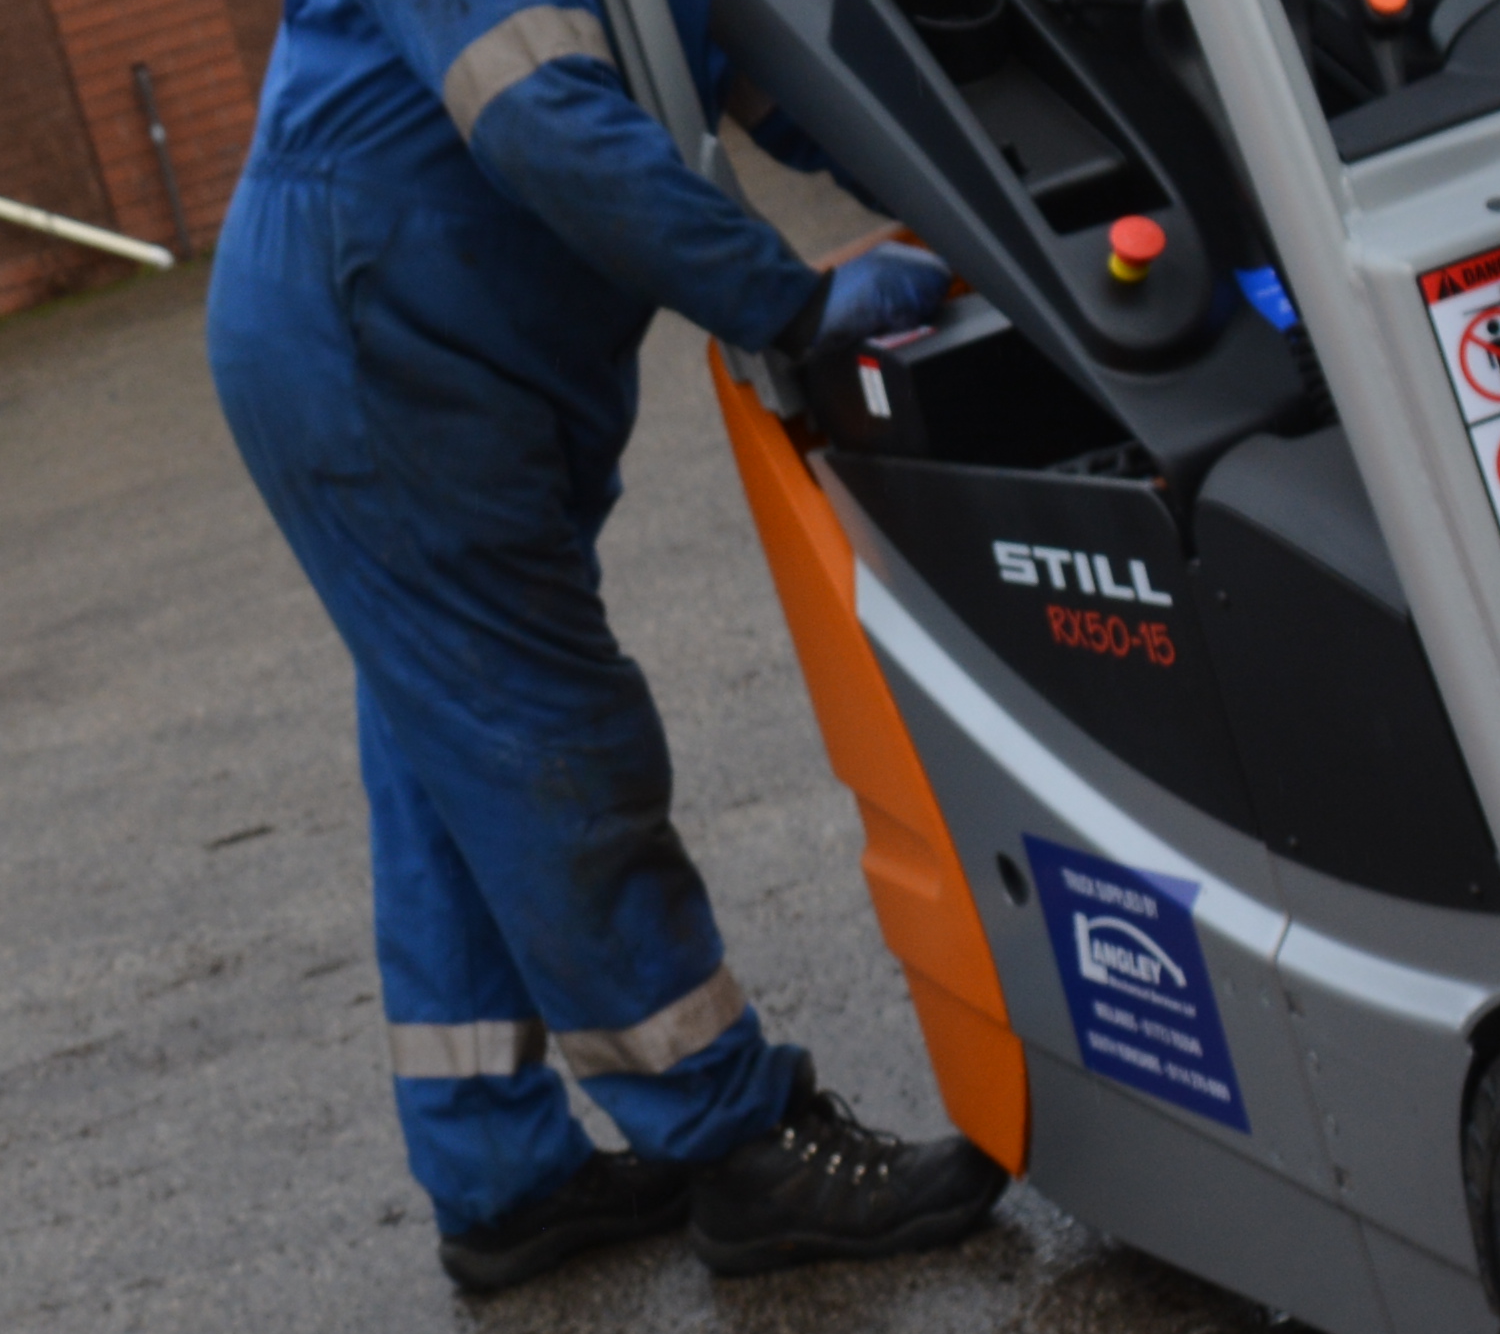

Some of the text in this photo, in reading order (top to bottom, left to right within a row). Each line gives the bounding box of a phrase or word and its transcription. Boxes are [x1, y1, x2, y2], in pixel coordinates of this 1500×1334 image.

[992, 539, 1174, 607] STILL
[1046, 604, 1176, 666] RX50-15
[1073, 911, 1162, 986] LANGLEY
